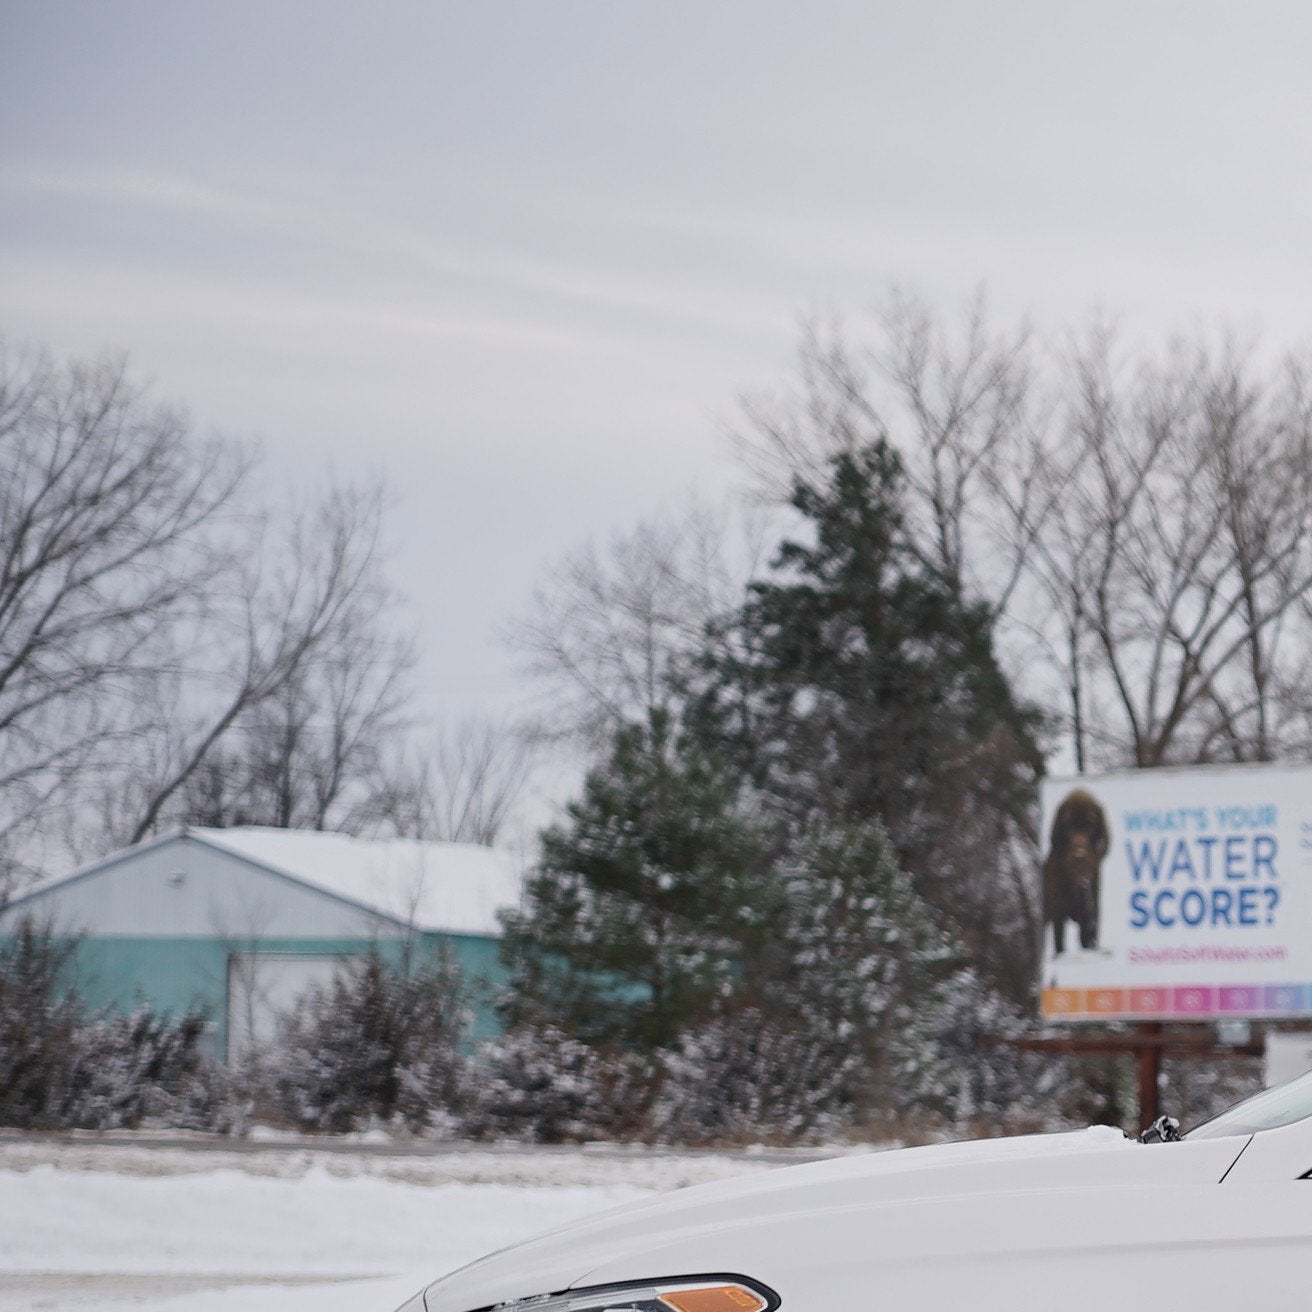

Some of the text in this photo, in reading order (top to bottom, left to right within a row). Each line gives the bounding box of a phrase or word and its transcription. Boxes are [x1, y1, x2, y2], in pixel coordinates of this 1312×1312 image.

[1123, 805, 1277, 832] WHAT'S YOUR
[1125, 835, 1279, 881] WATER
[1129, 887, 1280, 928] SCORE?
